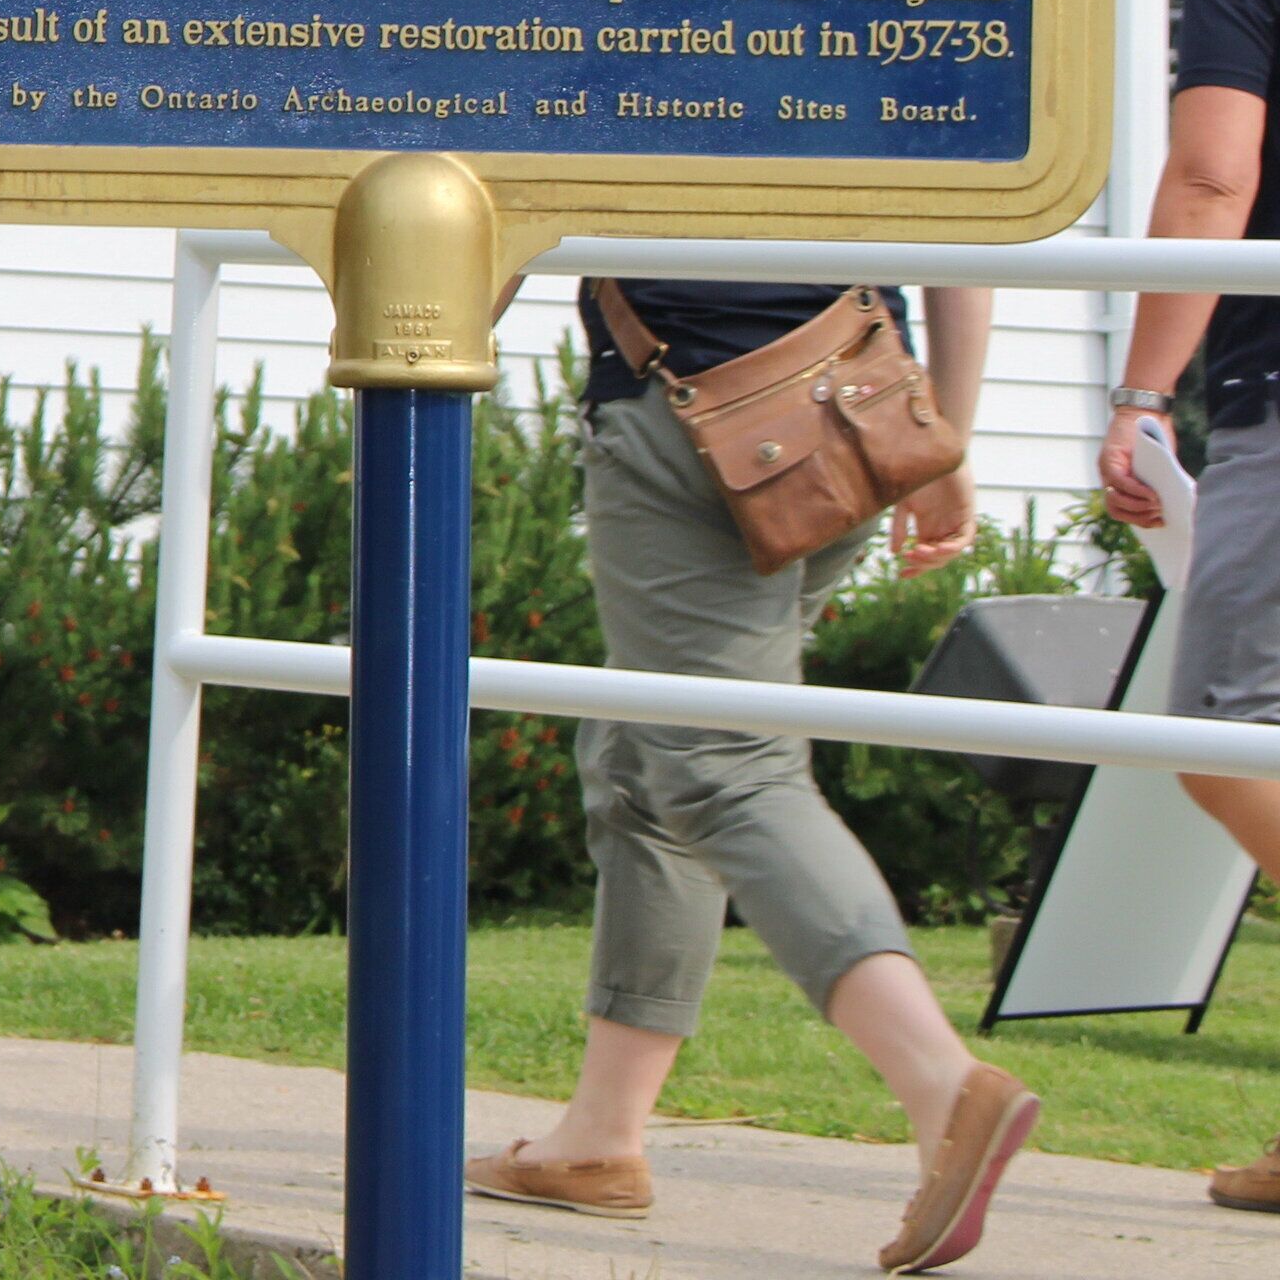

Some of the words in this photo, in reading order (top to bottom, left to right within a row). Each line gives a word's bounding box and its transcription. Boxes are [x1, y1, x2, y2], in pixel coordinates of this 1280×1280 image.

[72, 8, 109, 44] of
[122, 18, 172, 46] an
[182, 14, 367, 49] extensive
[379, 16, 586, 53] restoration
[596, 18, 738, 56] carried
[746, 24, 806, 57] out
[819, 22, 859, 58] in
[867, 18, 1016, 66] 1937-38.
[11, 83, 47, 112] by
[72, 84, 119, 109] the
[139, 84, 259, 111] Ontario
[284, 88, 508, 120] Archaeological
[535, 90, 588, 117] and
[617, 92, 745, 120] Historic
[777, 94, 848, 121] Sites
[880, 95, 978, 123] Board.
